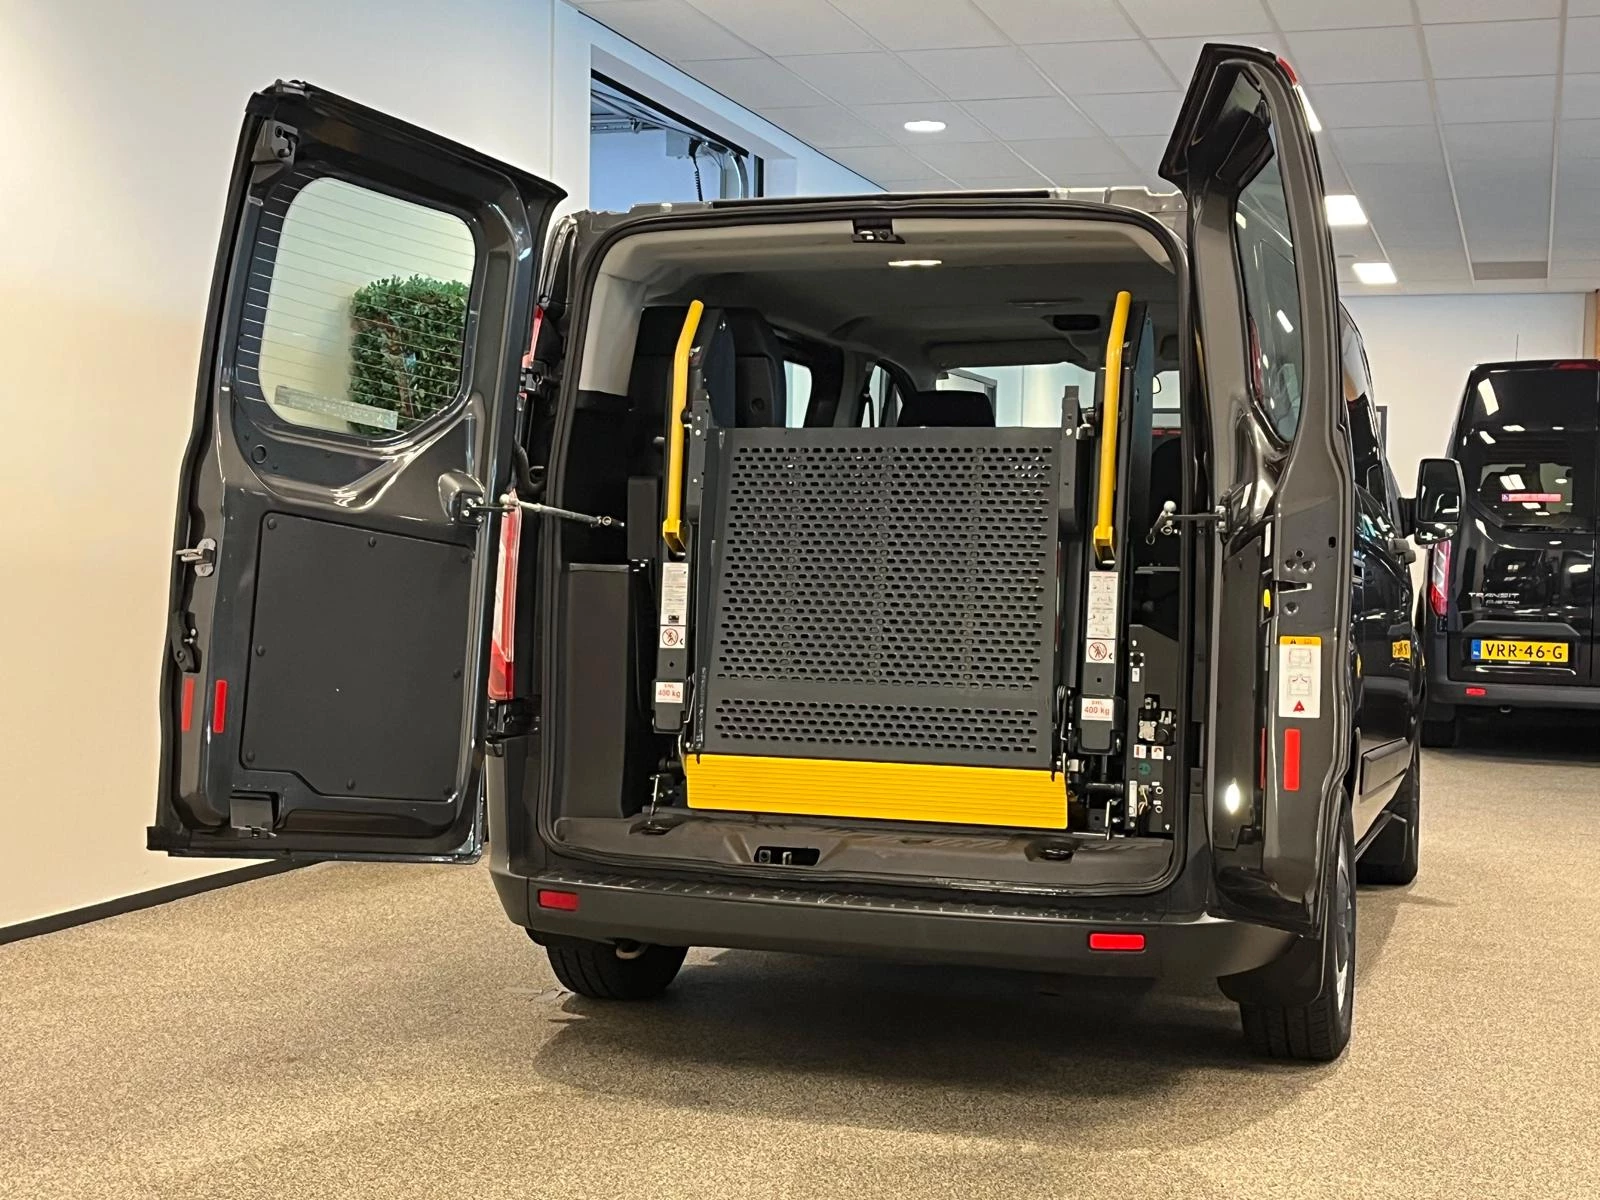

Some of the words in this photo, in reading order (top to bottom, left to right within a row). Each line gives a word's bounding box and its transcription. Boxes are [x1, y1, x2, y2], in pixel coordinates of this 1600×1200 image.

[1485, 643, 1563, 660] VRR-46-G
[671, 689, 681, 699] kg
[1083, 706, 1099, 714] 400
[1100, 706, 1110, 716] kg
